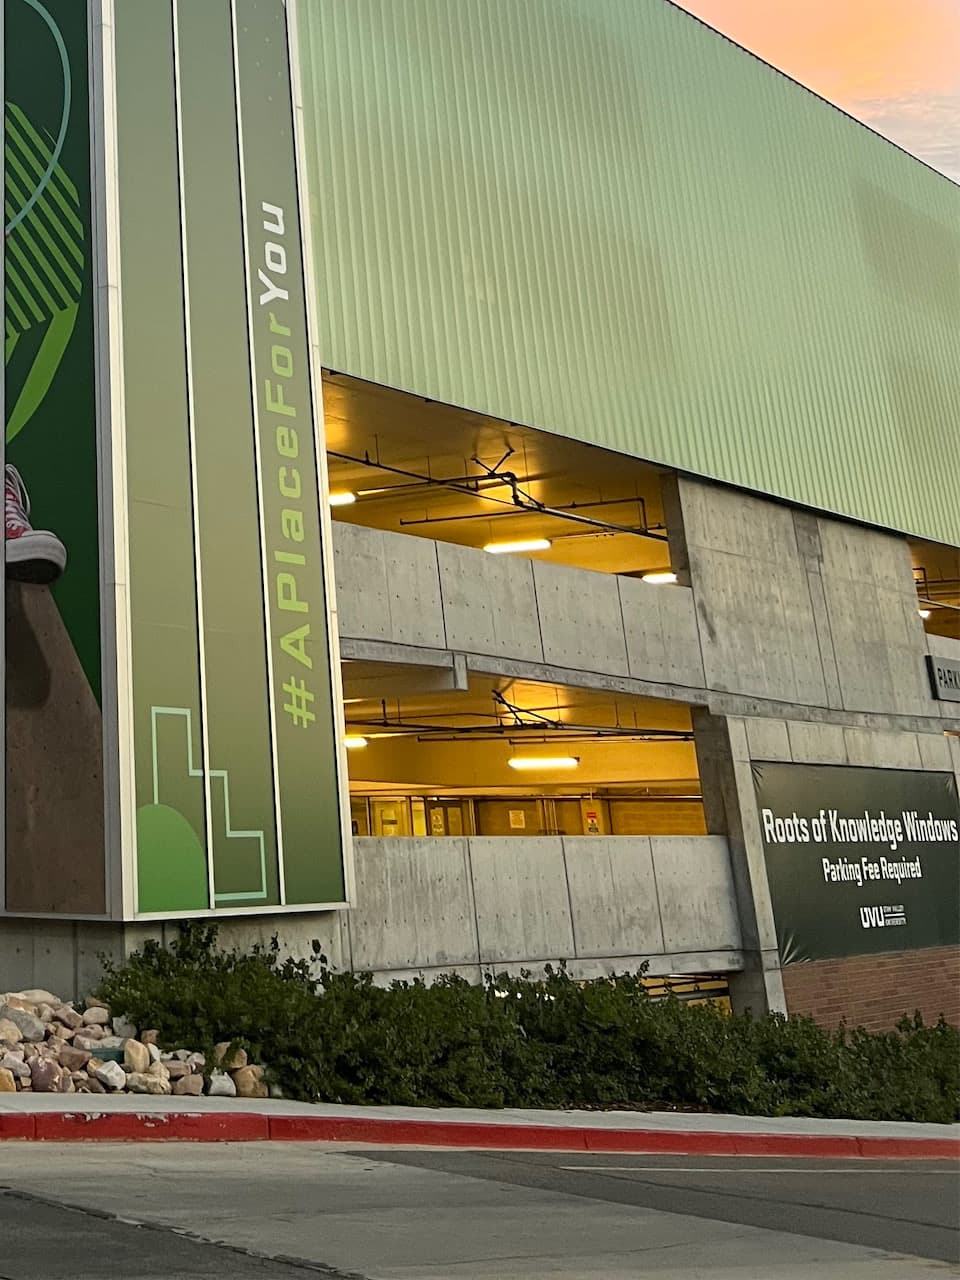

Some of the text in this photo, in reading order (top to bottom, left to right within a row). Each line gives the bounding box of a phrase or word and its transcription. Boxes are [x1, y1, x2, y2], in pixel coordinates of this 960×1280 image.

[257, 201, 316, 729] #APlaceForYou
[762, 808, 959, 850] Roots of Knowledge Windows
[822, 855, 922, 886] Parking Fee Required
[860, 905, 884, 928] UVU
